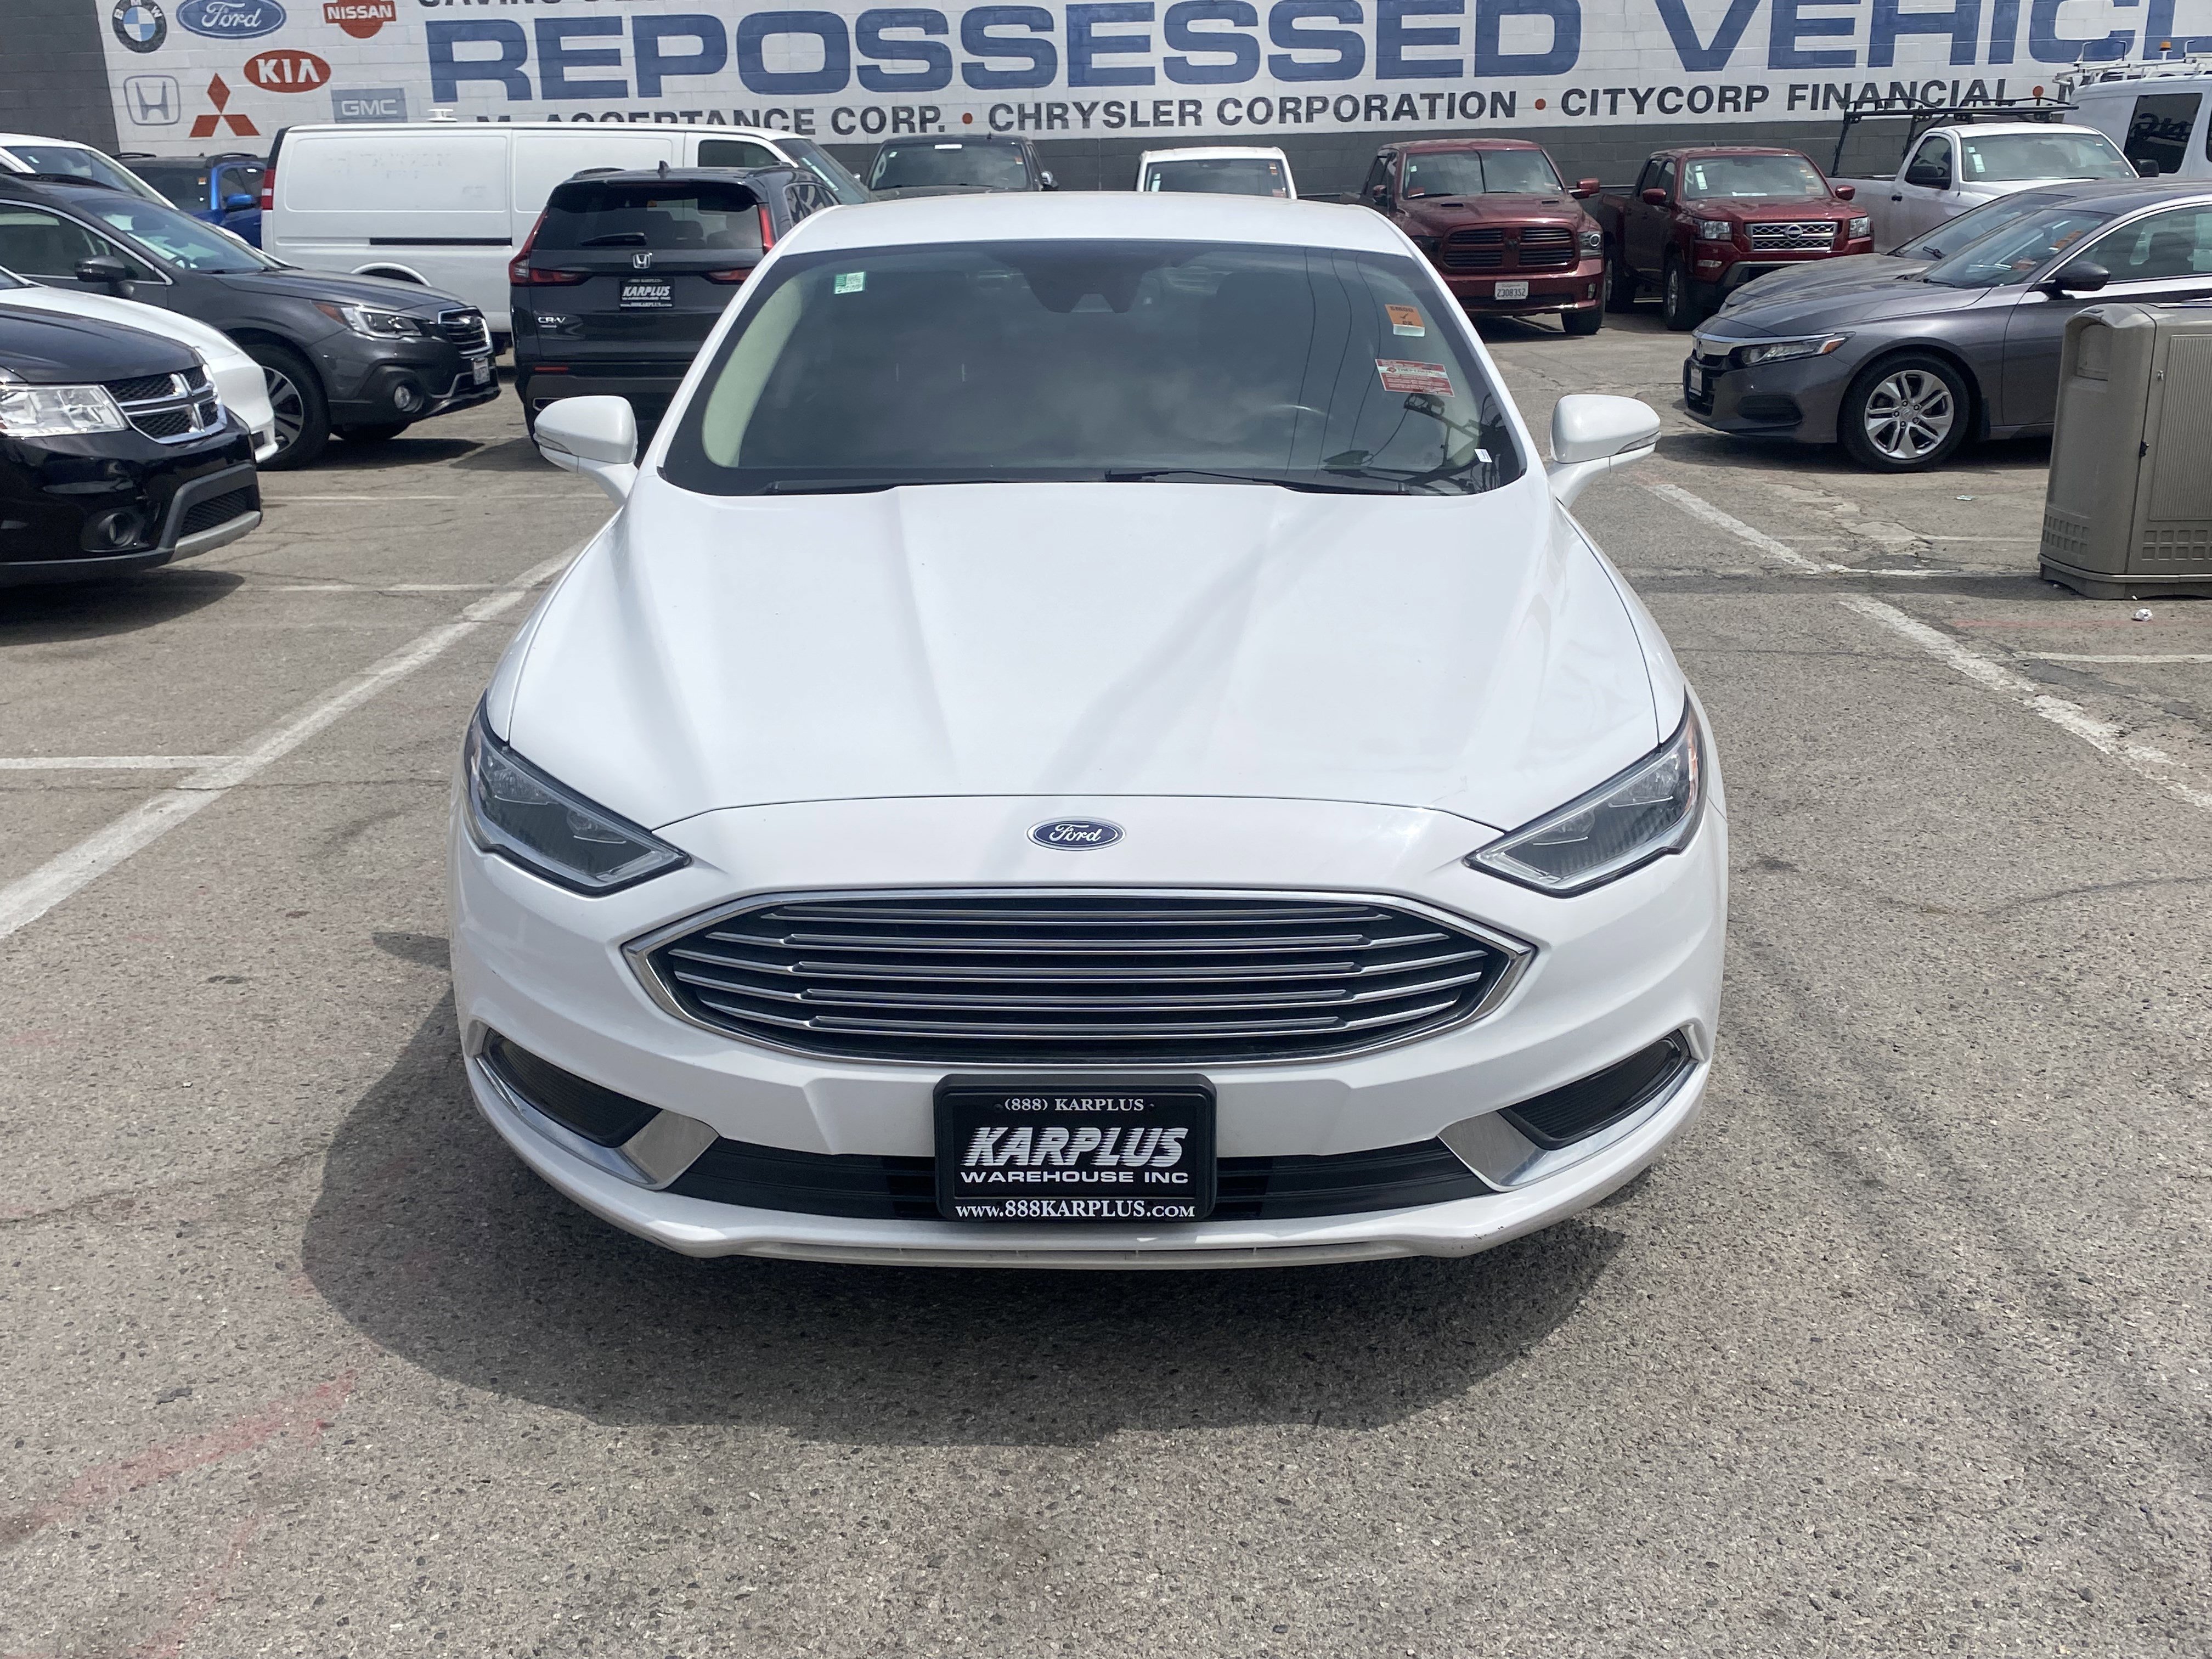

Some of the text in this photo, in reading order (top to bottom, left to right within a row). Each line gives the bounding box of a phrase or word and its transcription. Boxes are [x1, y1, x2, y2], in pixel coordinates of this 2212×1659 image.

[201, 1, 262, 27] Ford
[328, 4, 392, 20] NISSAN
[425, 0, 1582, 103] REPOSSESSED
[255, 58, 320, 83] KIA
[341, 99, 398, 116] GMC
[831, 106, 945, 135] CORP.
[988, 99, 1203, 132] CHRYSLER
[1216, 91, 1517, 126] CORPORATION
[1561, 84, 1770, 116] CITYCORP
[1787, 78, 2016, 112] FINANCIAL
[622, 286, 670, 297] KARPLUS
[1048, 823, 1103, 842] Ford
[1004, 1098, 1144, 1111] (888) KARPLUS
[960, 1126, 1189, 1167] KARPLUS
[960, 1171, 1189, 1183] WAREHOUSE INC
